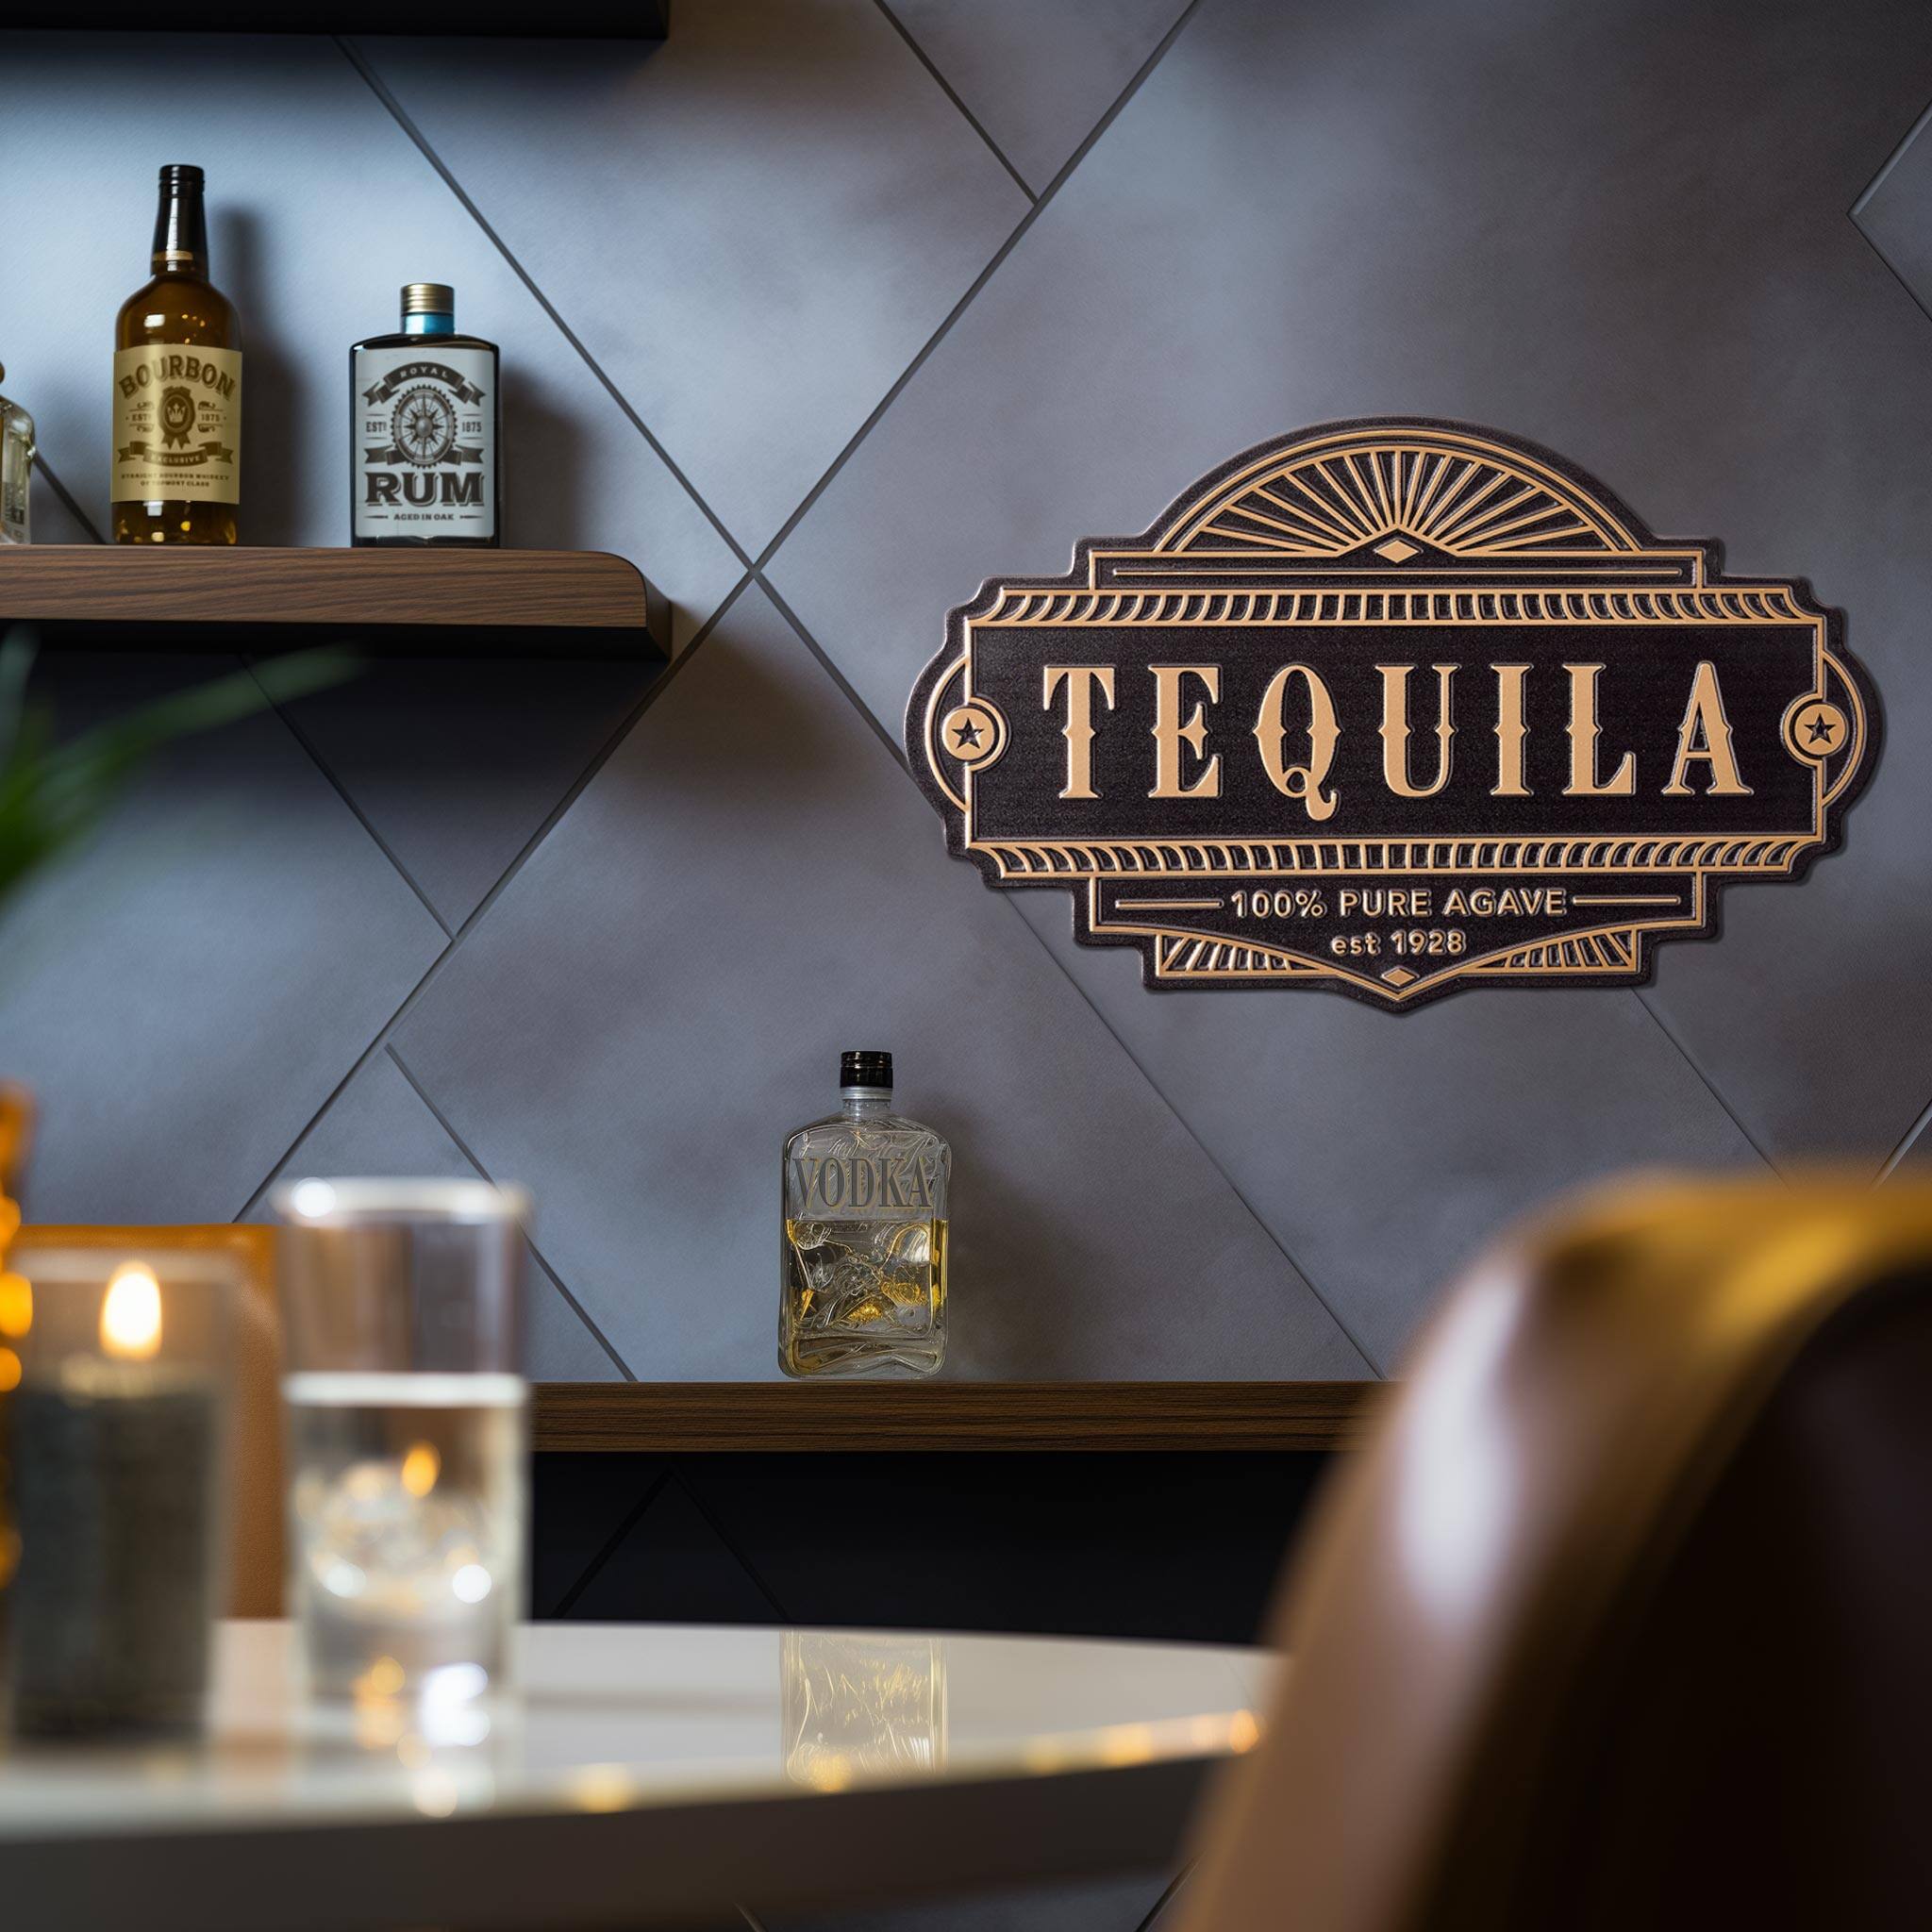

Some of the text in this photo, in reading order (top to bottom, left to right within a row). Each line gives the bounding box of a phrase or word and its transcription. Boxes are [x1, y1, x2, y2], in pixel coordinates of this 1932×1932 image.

[119, 355, 236, 401] BOURBON
[399, 366, 448, 379] ROYAL
[462, 422, 482, 433] 1875
[150, 454, 201, 464] EXCLUSIVE
[364, 472, 486, 508] RUM
[1042, 660, 1755, 821] TEQUILA
[1230, 888, 1568, 919] 100% PURE AGAVE
[1330, 928, 1468, 957] est 1928
[791, 1156, 934, 1209] VODKA
